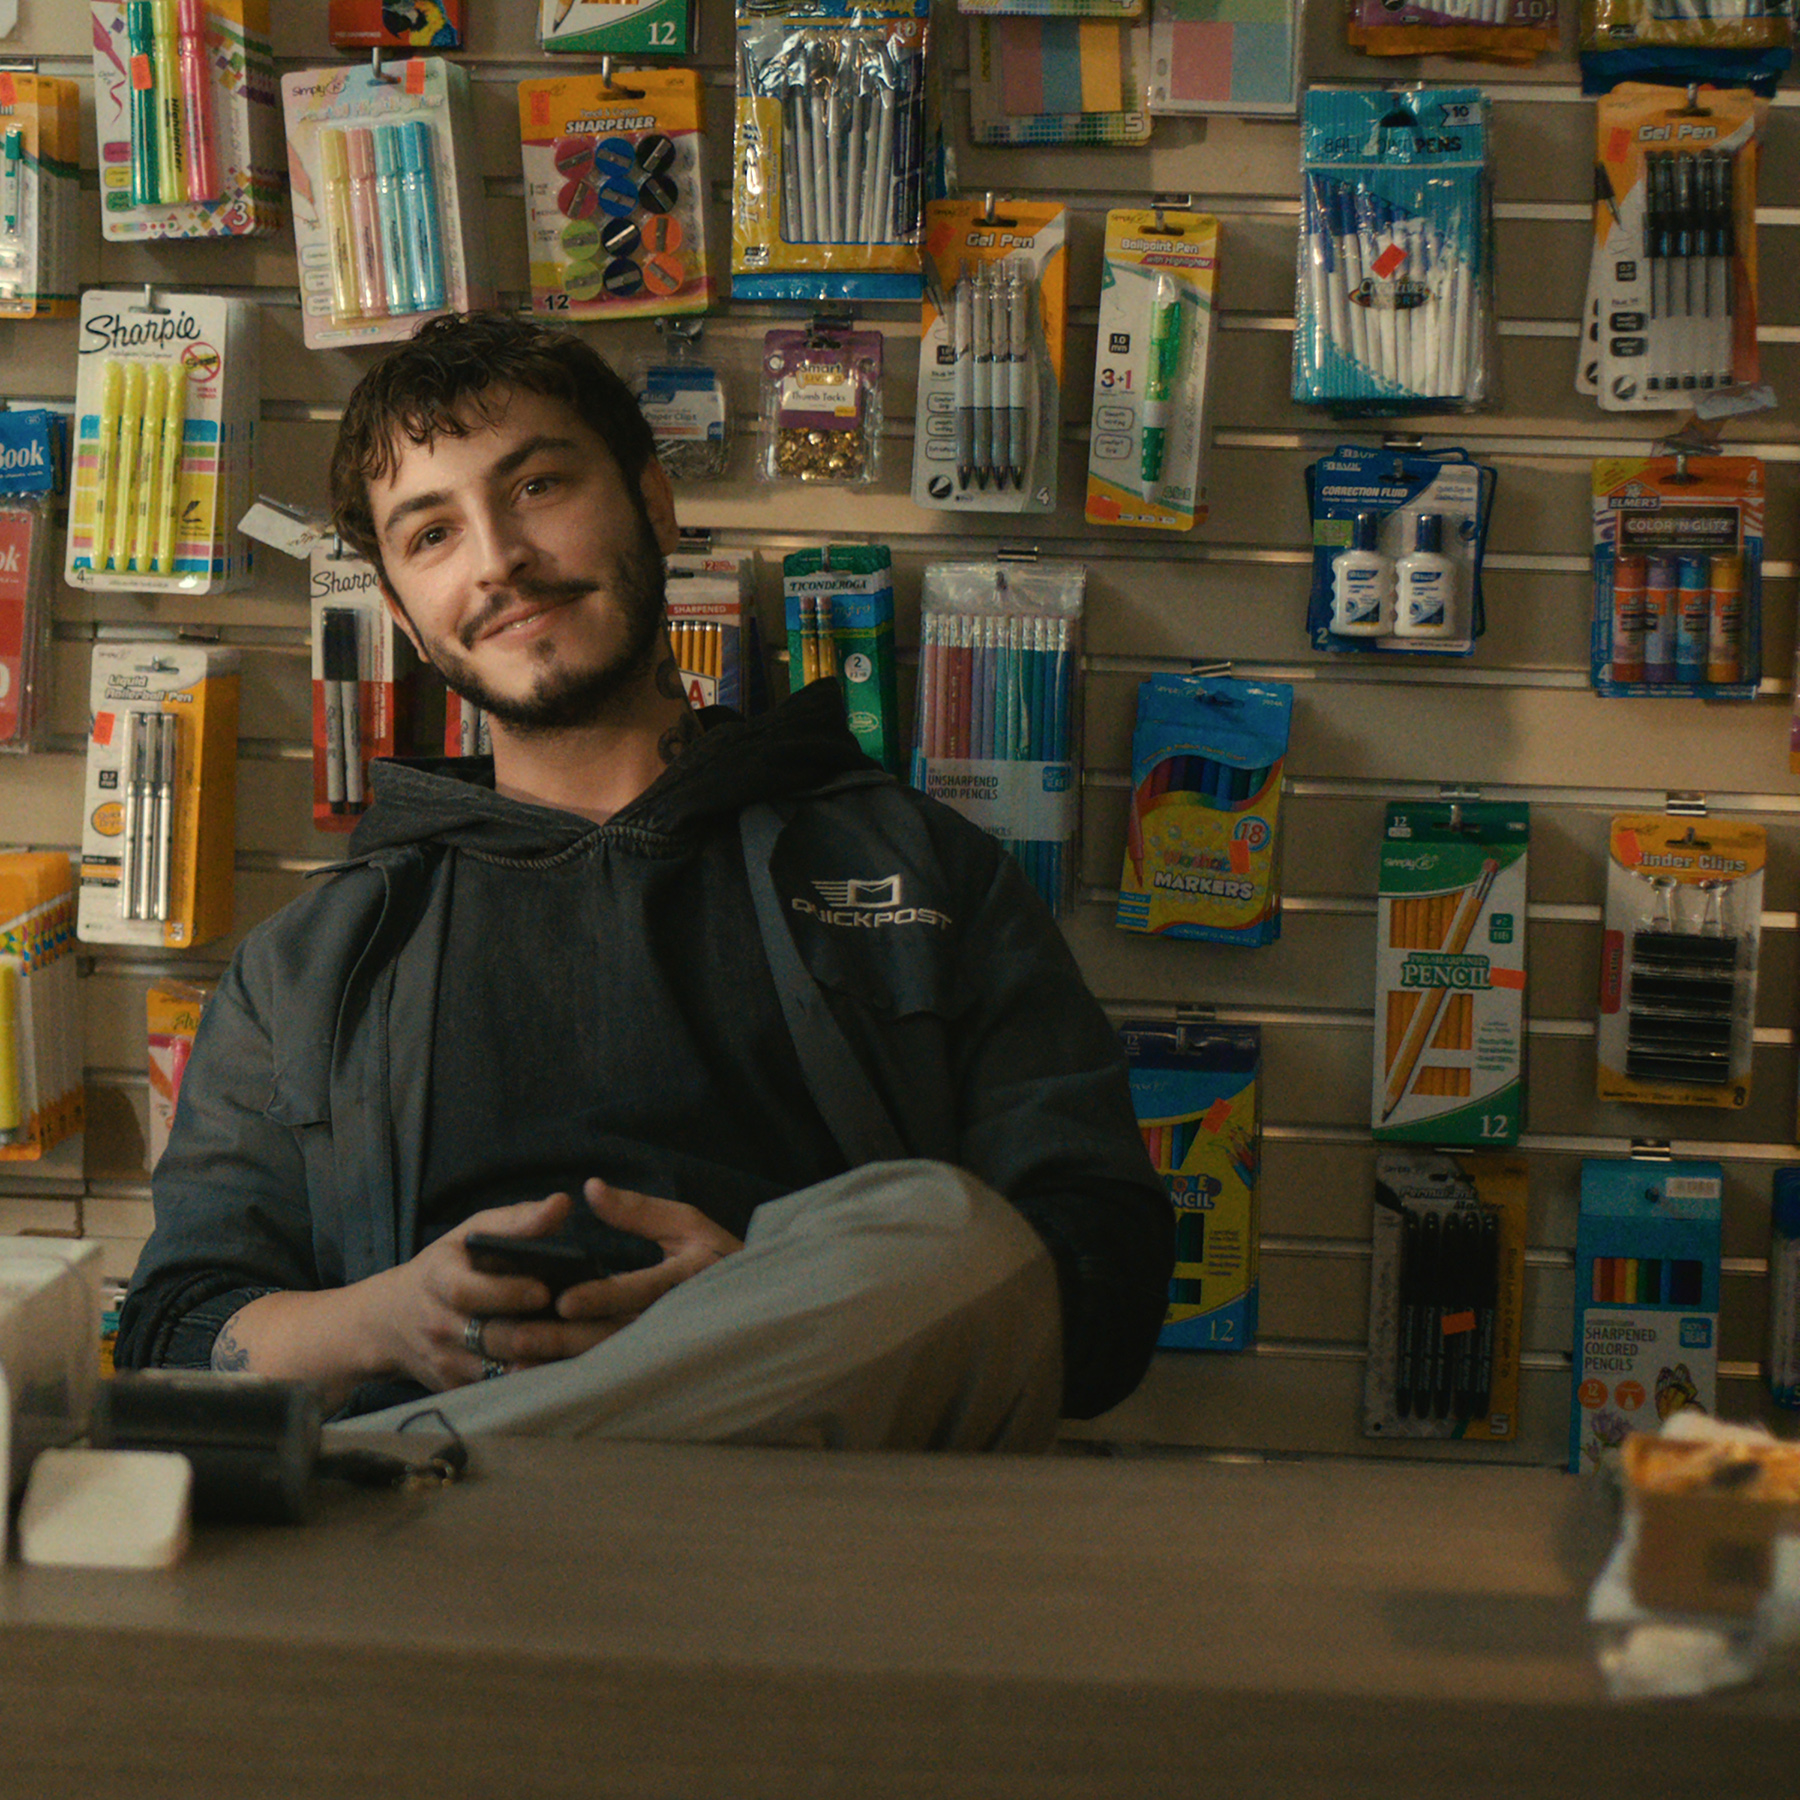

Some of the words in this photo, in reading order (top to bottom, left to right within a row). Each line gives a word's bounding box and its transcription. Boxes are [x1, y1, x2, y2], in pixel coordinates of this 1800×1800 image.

[647, 21, 677, 46] 12
[1451, 105, 1469, 117] 10
[565, 116, 656, 134] SHARPENER
[1122, 112, 1145, 133] 5
[1638, 125, 1672, 141] Gel
[1677, 124, 1717, 140] Pen
[1415, 135, 1462, 153] PENS
[232, 202, 248, 225] 3
[966, 232, 995, 249] Gel
[999, 233, 1035, 249] Pen
[1121, 238, 1172, 253] Ballpoint
[1175, 241, 1199, 255] Pen
[544, 294, 570, 311] 12
[79, 310, 201, 354] Sharpie
[1036, 488, 1050, 504] 4
[1321, 485, 1380, 497] CORRECTION
[1380, 487, 1409, 498] FLUID
[1626, 518, 1675, 532] COLOR
[310, 570, 379, 598] Sharp
[789, 579, 868, 592] TICONDEROGA
[673, 605, 728, 614] SHARPENED
[1316, 627, 1328, 645] 2
[853, 656, 862, 668] 2
[167, 690, 194, 704] Pen
[927, 774, 999, 788] UNSHARPENED
[927, 787, 958, 799] WOOD
[959, 788, 999, 801] PENCILS
[1393, 815, 1408, 827] 12
[1239, 822, 1265, 846] 18
[1636, 852, 1695, 869] inder
[1699, 854, 1746, 873] Clips
[1153, 870, 1255, 901] MARKERS
[792, 897, 953, 931] QUICKPOST
[170, 922, 185, 941] 3
[1403, 963, 1491, 988] PENCIL
[1479, 1114, 1510, 1139] 12
[1170, 1189, 1215, 1209] NCIL
[1208, 1318, 1236, 1344] 12
[1584, 1327, 1657, 1342] SHARPENED
[1584, 1341, 1640, 1356] COLORED
[1584, 1356, 1633, 1371] PENCILS
[1489, 1414, 1510, 1435] 5
